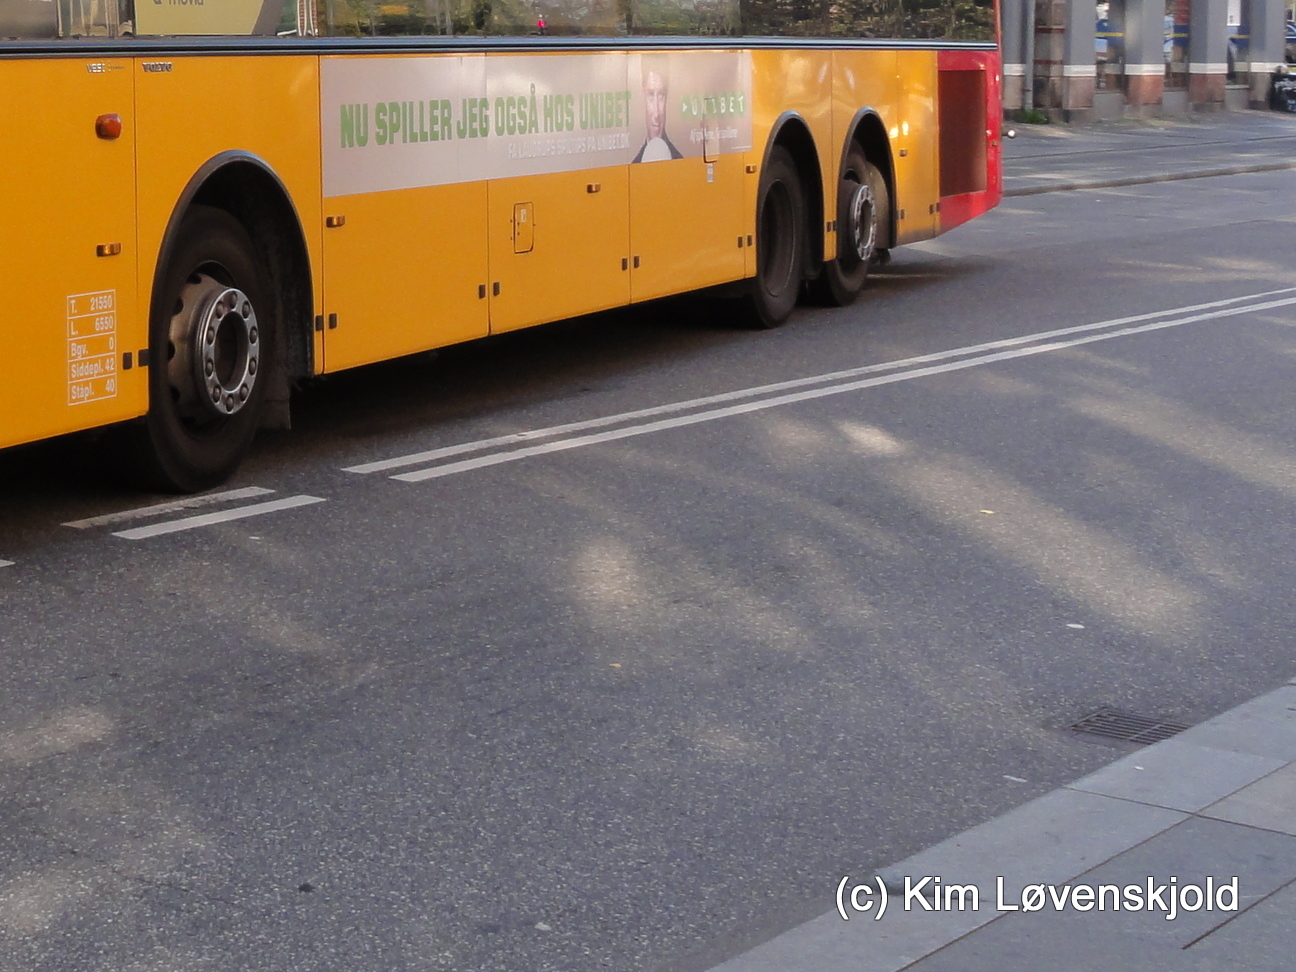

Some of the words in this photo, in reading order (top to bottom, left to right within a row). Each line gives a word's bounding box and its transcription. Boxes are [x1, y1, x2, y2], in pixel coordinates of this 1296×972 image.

[340, 103, 369, 148] NU
[375, 99, 452, 146] SPILLER
[456, 97, 489, 139] JEG
[494, 83, 539, 136] OGSÅ
[543, 94, 574, 132] HOS
[579, 91, 631, 130] UNIBET
[70, 321, 79, 336] L.
[105, 357, 115, 372] 42
[105, 378, 115, 392] 40
